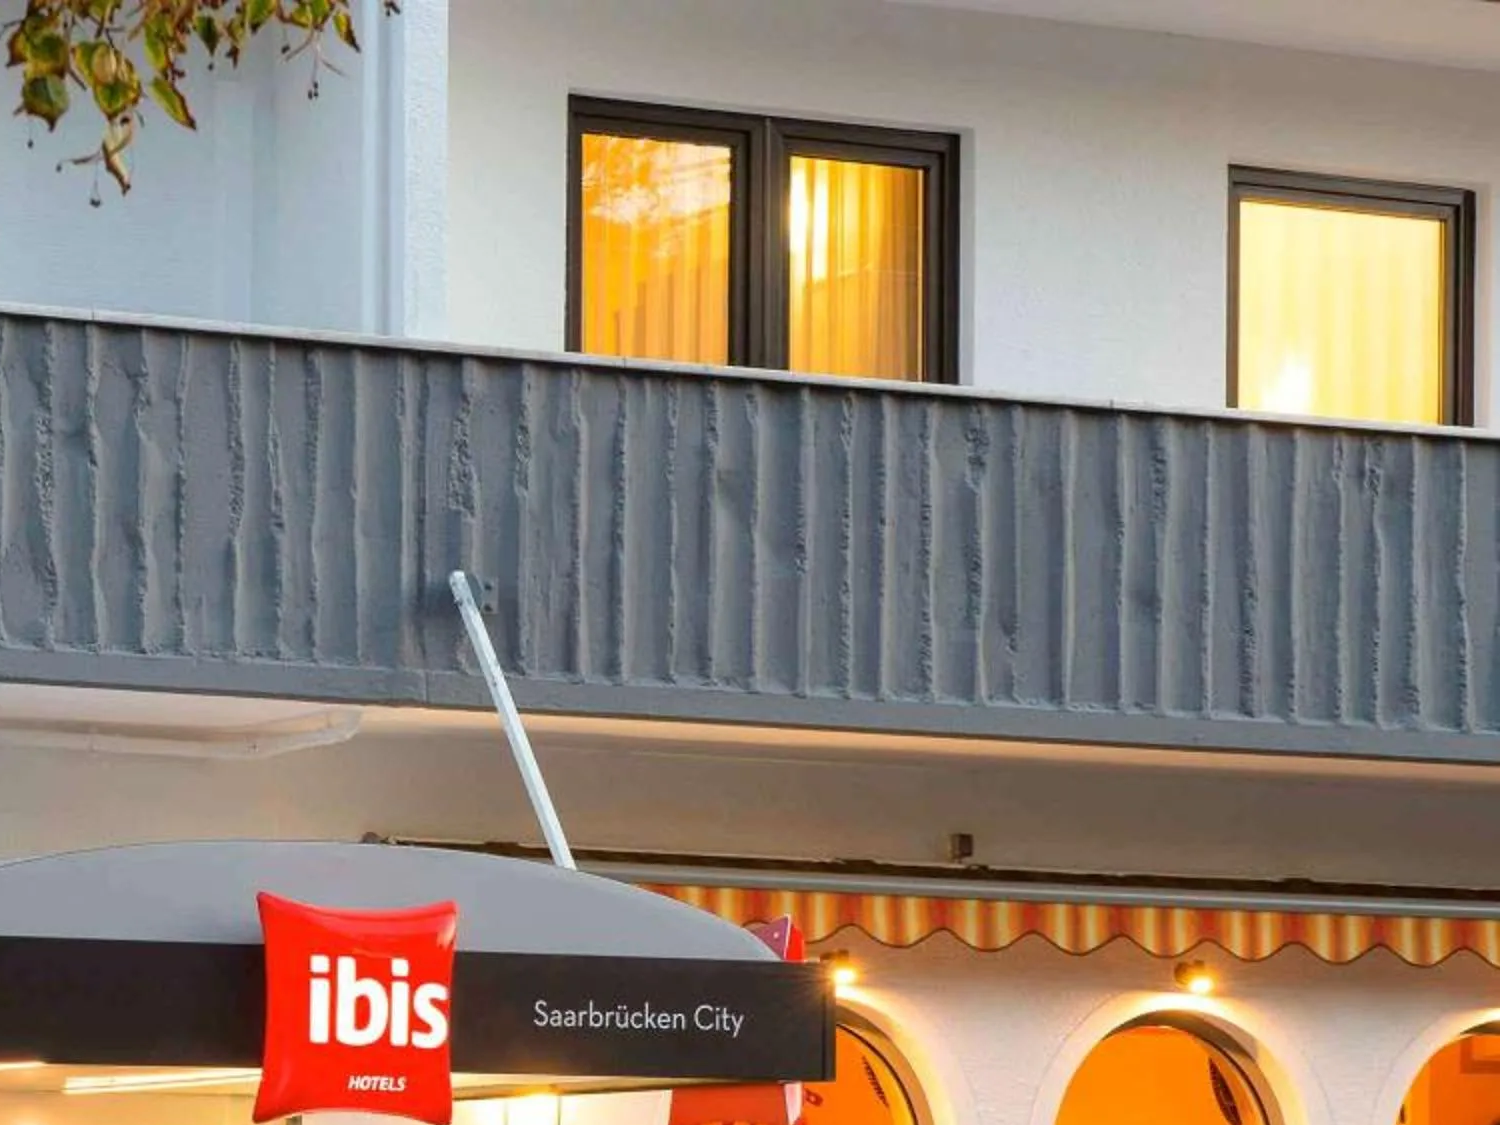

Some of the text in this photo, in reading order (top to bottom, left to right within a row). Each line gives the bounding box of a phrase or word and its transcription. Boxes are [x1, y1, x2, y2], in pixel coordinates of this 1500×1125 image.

[309, 954, 449, 1049] ibis
[533, 999, 745, 1038] Saarbrücken City
[348, 1075, 407, 1092] HOTELS
